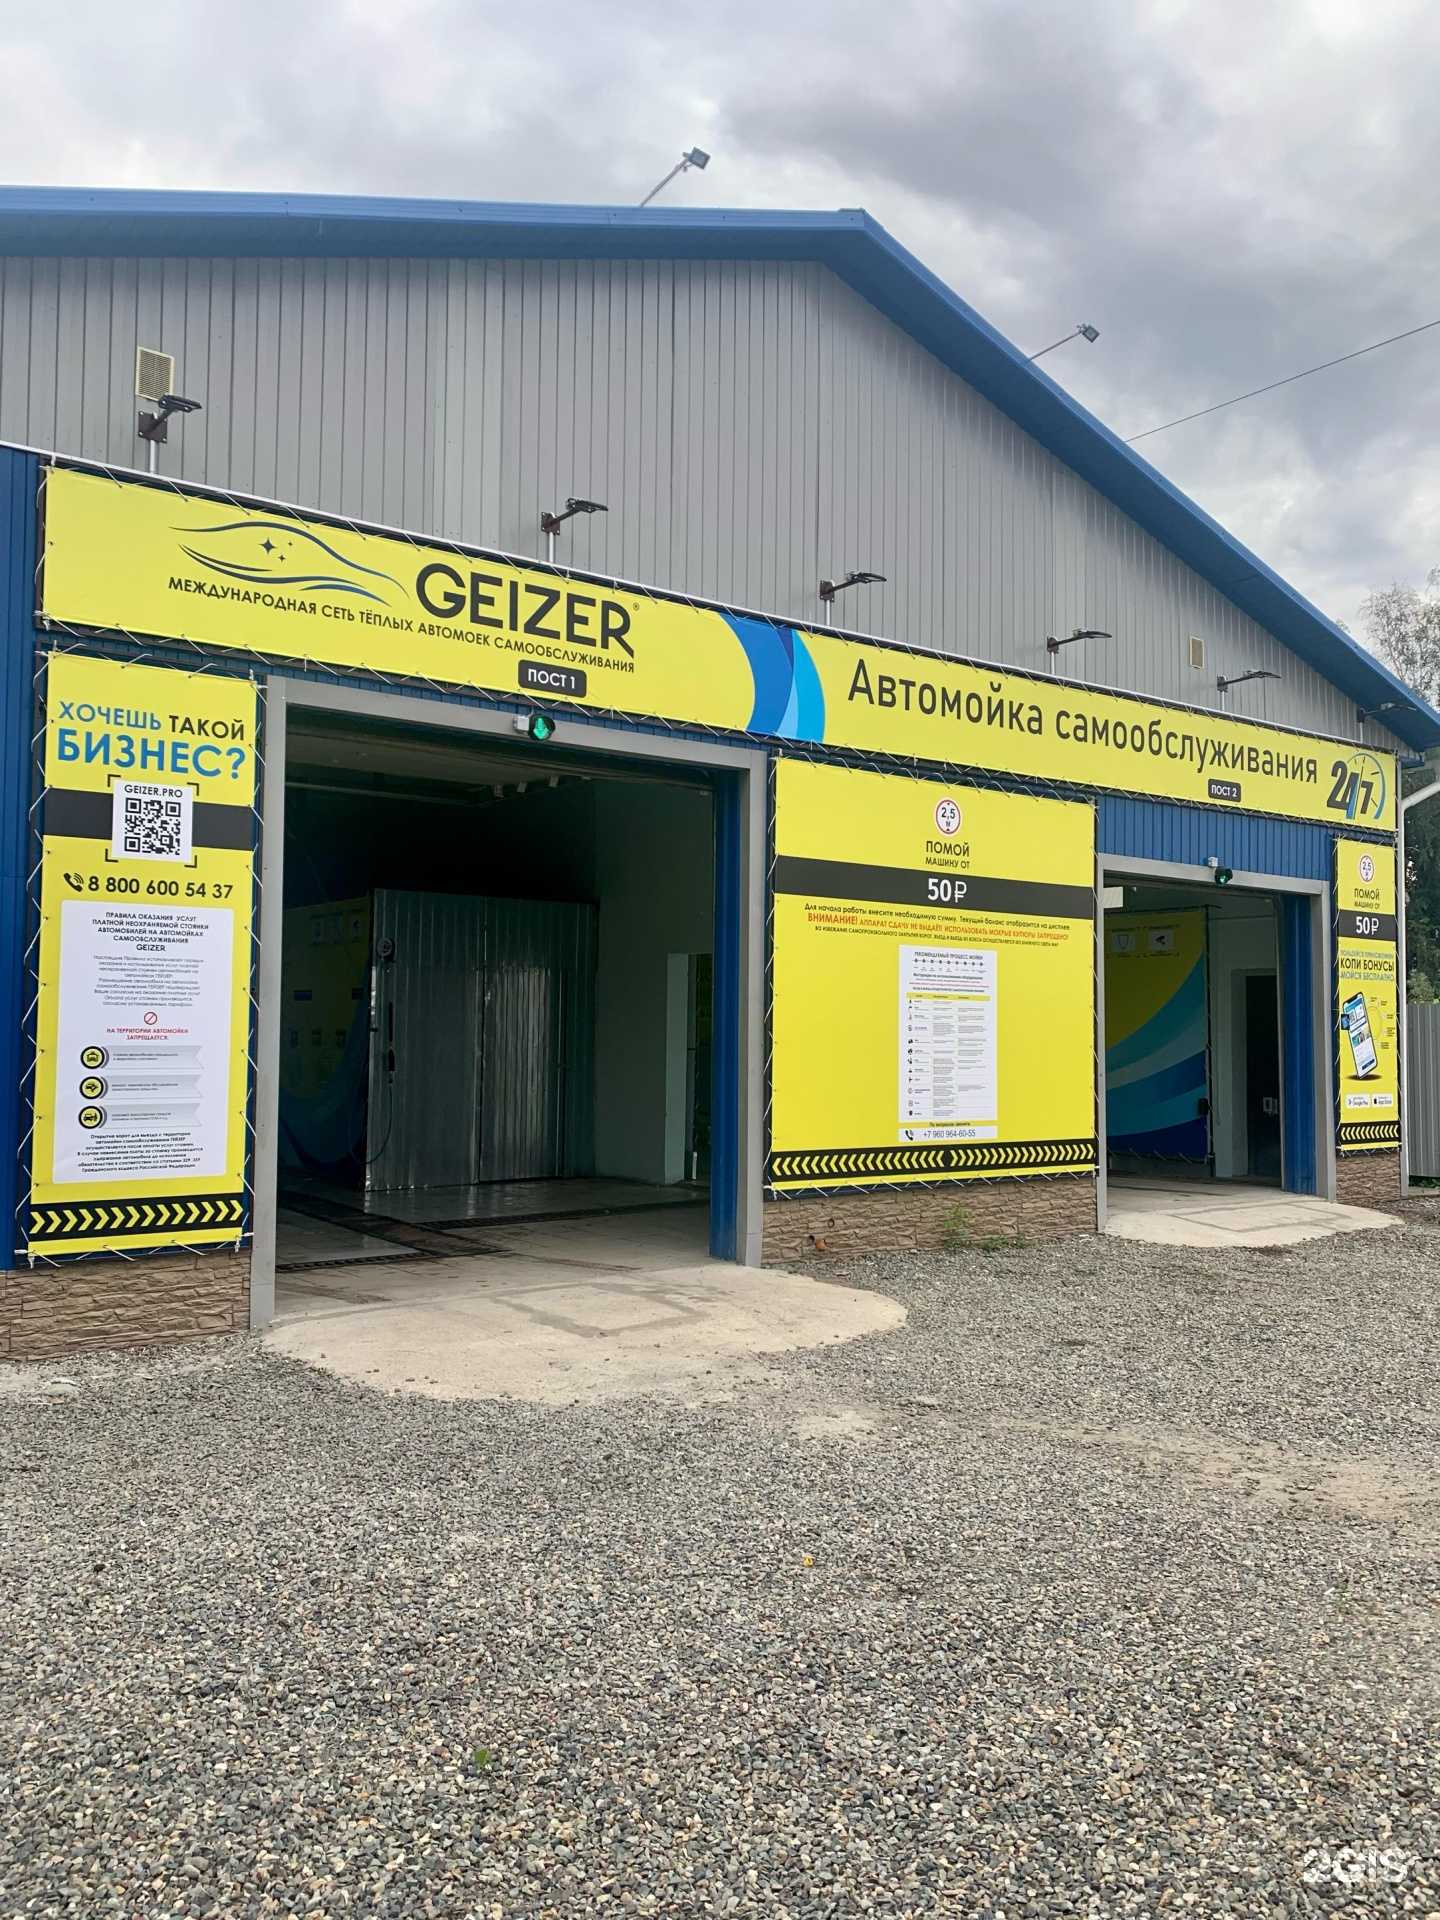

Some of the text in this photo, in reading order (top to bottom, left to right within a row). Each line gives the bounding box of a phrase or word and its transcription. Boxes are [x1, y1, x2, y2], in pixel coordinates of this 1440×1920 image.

[168, 577, 634, 673] МЕЖДУНАРОДНАЯ СЕТЬ ТЁПЛЫХ АВТОМОЕК САМООБСЛУЖИВАНИЯ
[528, 669, 576, 689] ПОСТ 1
[59, 701, 244, 740] ХОЧЕШЬ ТАКОЙ
[848, 659, 1317, 784] Автомойка самообслуживания
[58, 728, 245, 779] БИЗНЕС?
[124, 784, 183, 798] GEIZER.PRO
[1211, 785, 1238, 797] ПОСТ 2
[942, 807, 955, 819] 2,5
[926, 840, 970, 857] ПОМОЙ
[926, 857, 970, 869] МАШИНУ ОТ
[88, 876, 233, 899] 8 800 600 54 37
[1354, 888, 1379, 900] ПОМОЙ
[138, 913, 173, 921] ОКАЗАНИЯ
[818, 905, 841, 913] начала
[868, 909, 893, 917] внесите
[895, 911, 935, 920] необходимую
[92, 918, 124, 926] ПЛАТНОЙ
[125, 921, 178, 929] НЕОХРАНЯЕМОЙ
[808, 912, 858, 925] ВНИМАНИЕ!
[860, 919, 887, 927] АППАРАТ
[888, 921, 909, 929] СДАЧУ
[113, 935, 189, 944] САМООБСЛУЖИВАНИЯ
[159, 929, 203, 937] АВТОМОЙКАХ
[136, 944, 166, 952] GEIZER
[1340, 957, 1394, 971] КОПИ БОНУСЫ
